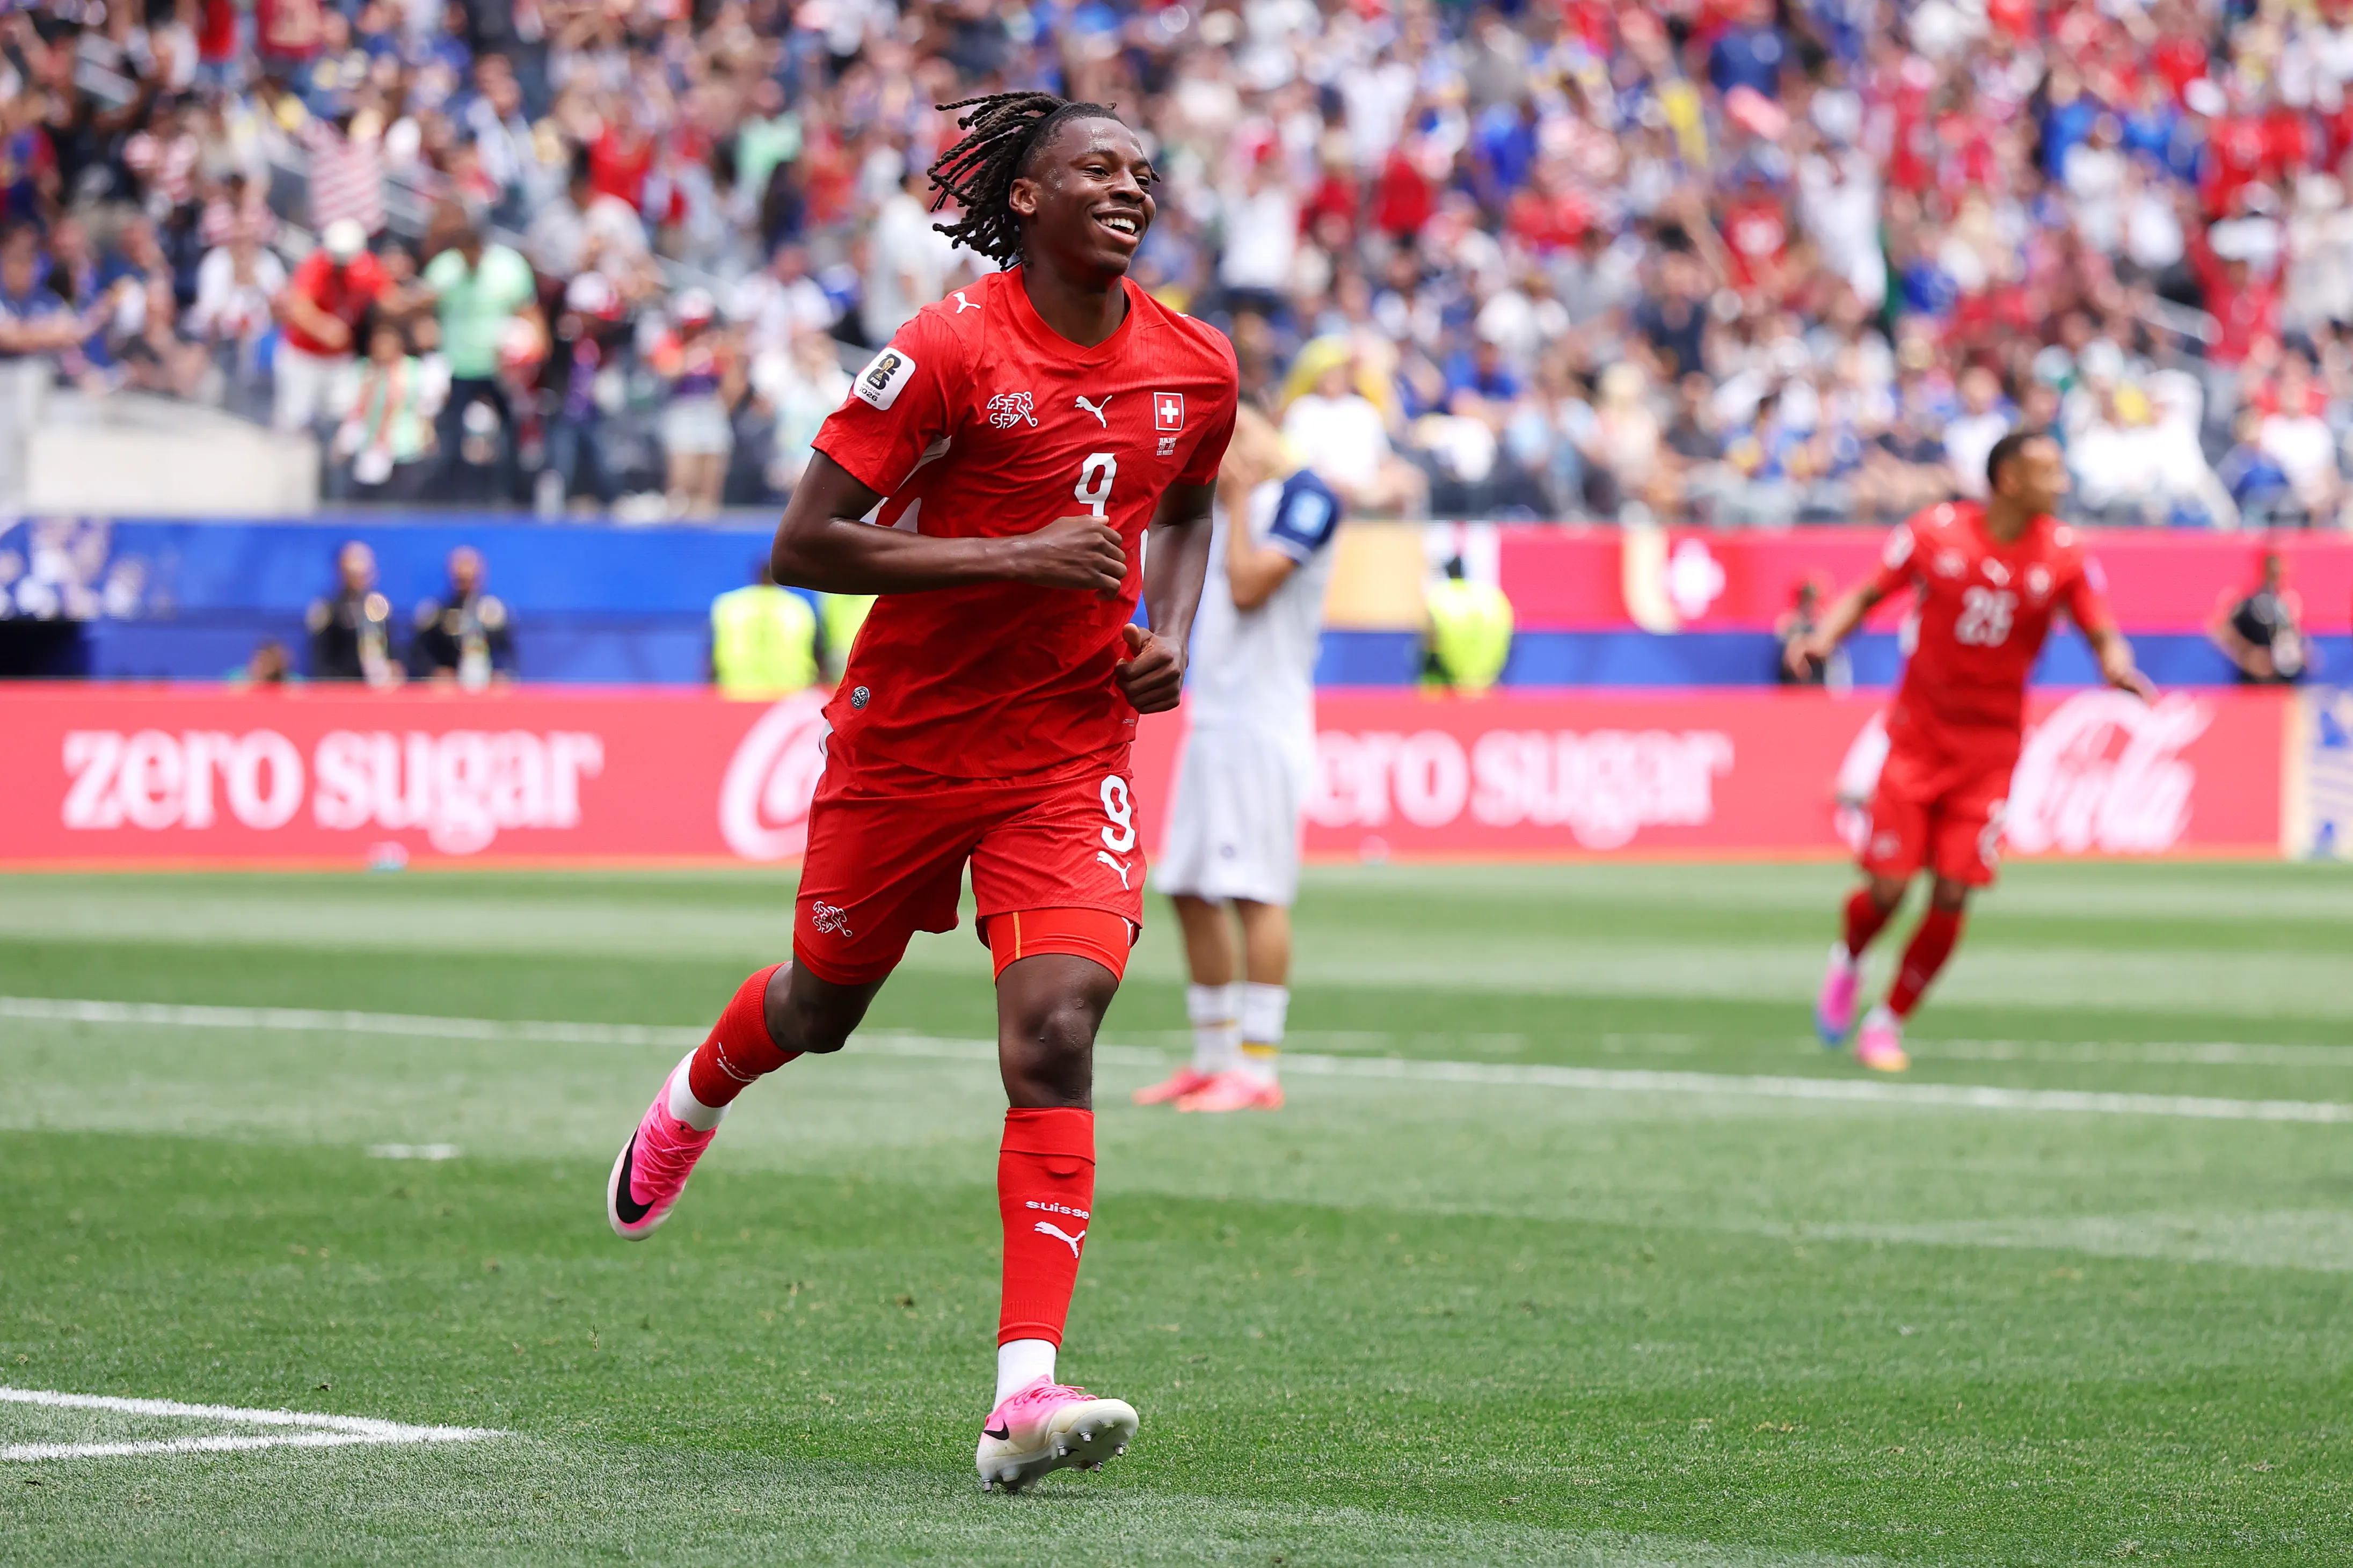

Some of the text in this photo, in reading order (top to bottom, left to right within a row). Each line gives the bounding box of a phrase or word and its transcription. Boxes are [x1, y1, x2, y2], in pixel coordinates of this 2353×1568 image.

[859, 386, 878, 402] 2026
[870, 377, 880, 386] FIFA
[1074, 453, 1117, 516] 9
[61, 728, 305, 830] zero
[314, 728, 604, 855] sugar
[1100, 775, 1135, 852] 9
[1303, 728, 1735, 850] ero sugar
[1025, 1201, 1090, 1220] suisse
